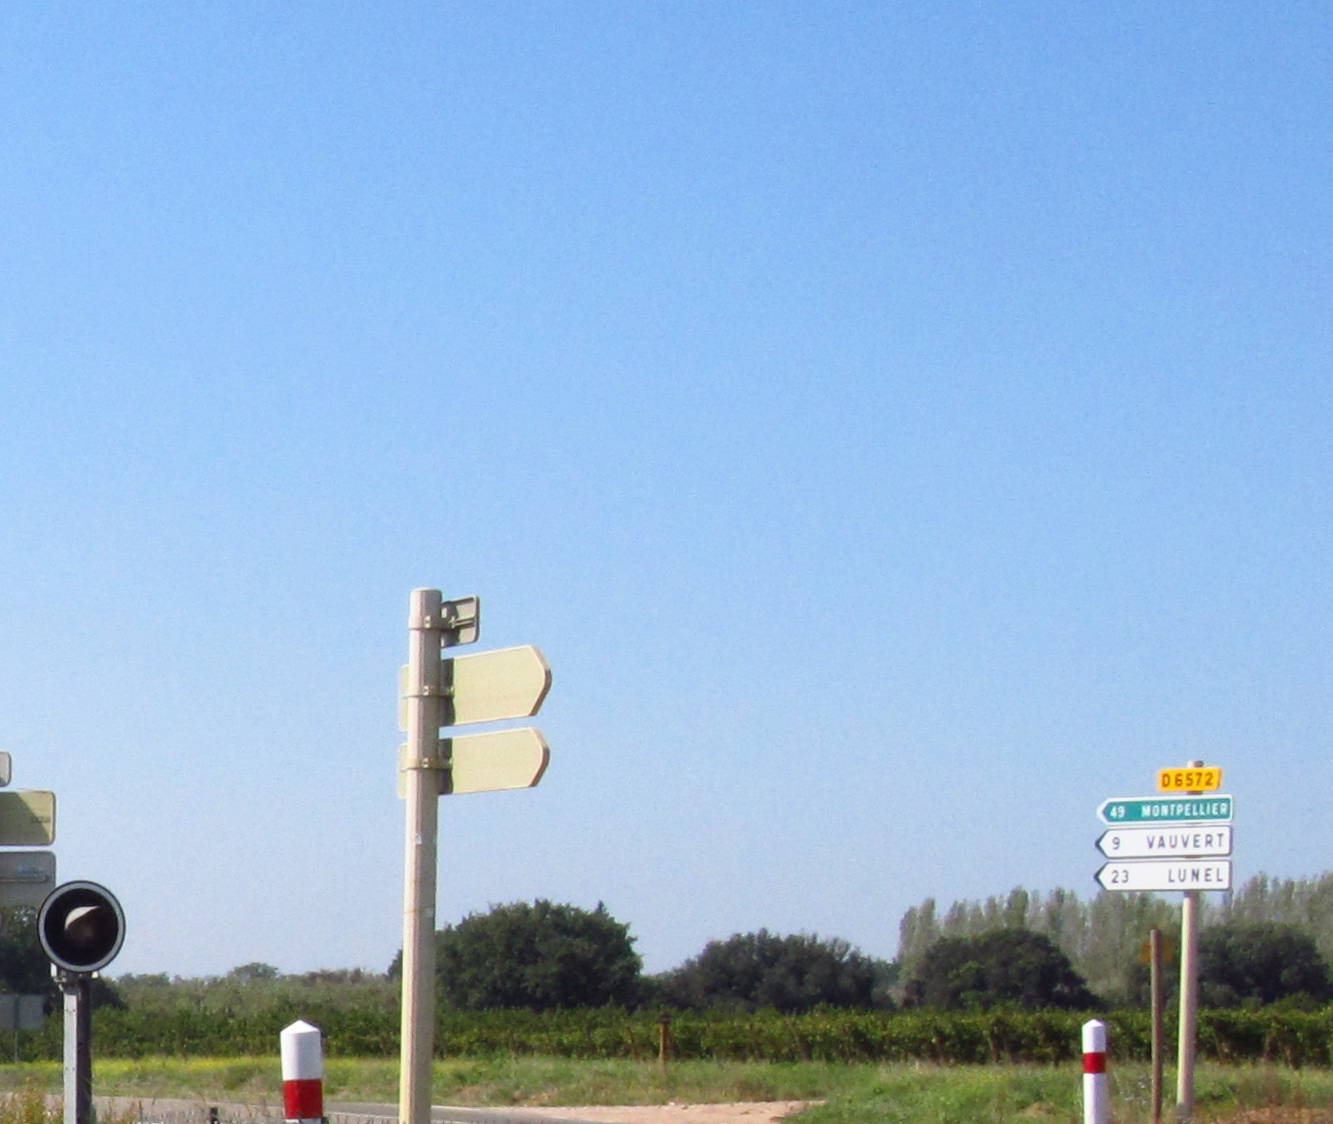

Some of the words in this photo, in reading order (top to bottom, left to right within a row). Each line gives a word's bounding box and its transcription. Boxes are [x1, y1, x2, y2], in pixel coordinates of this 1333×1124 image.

[1109, 804, 1126, 818] 49
[1140, 802, 1229, 818] MONTPELLIER
[1112, 837, 1121, 850] 9
[1147, 832, 1225, 849] VAUVERT
[1111, 870, 1130, 883] 23
[1168, 867, 1224, 883] LUNEL
